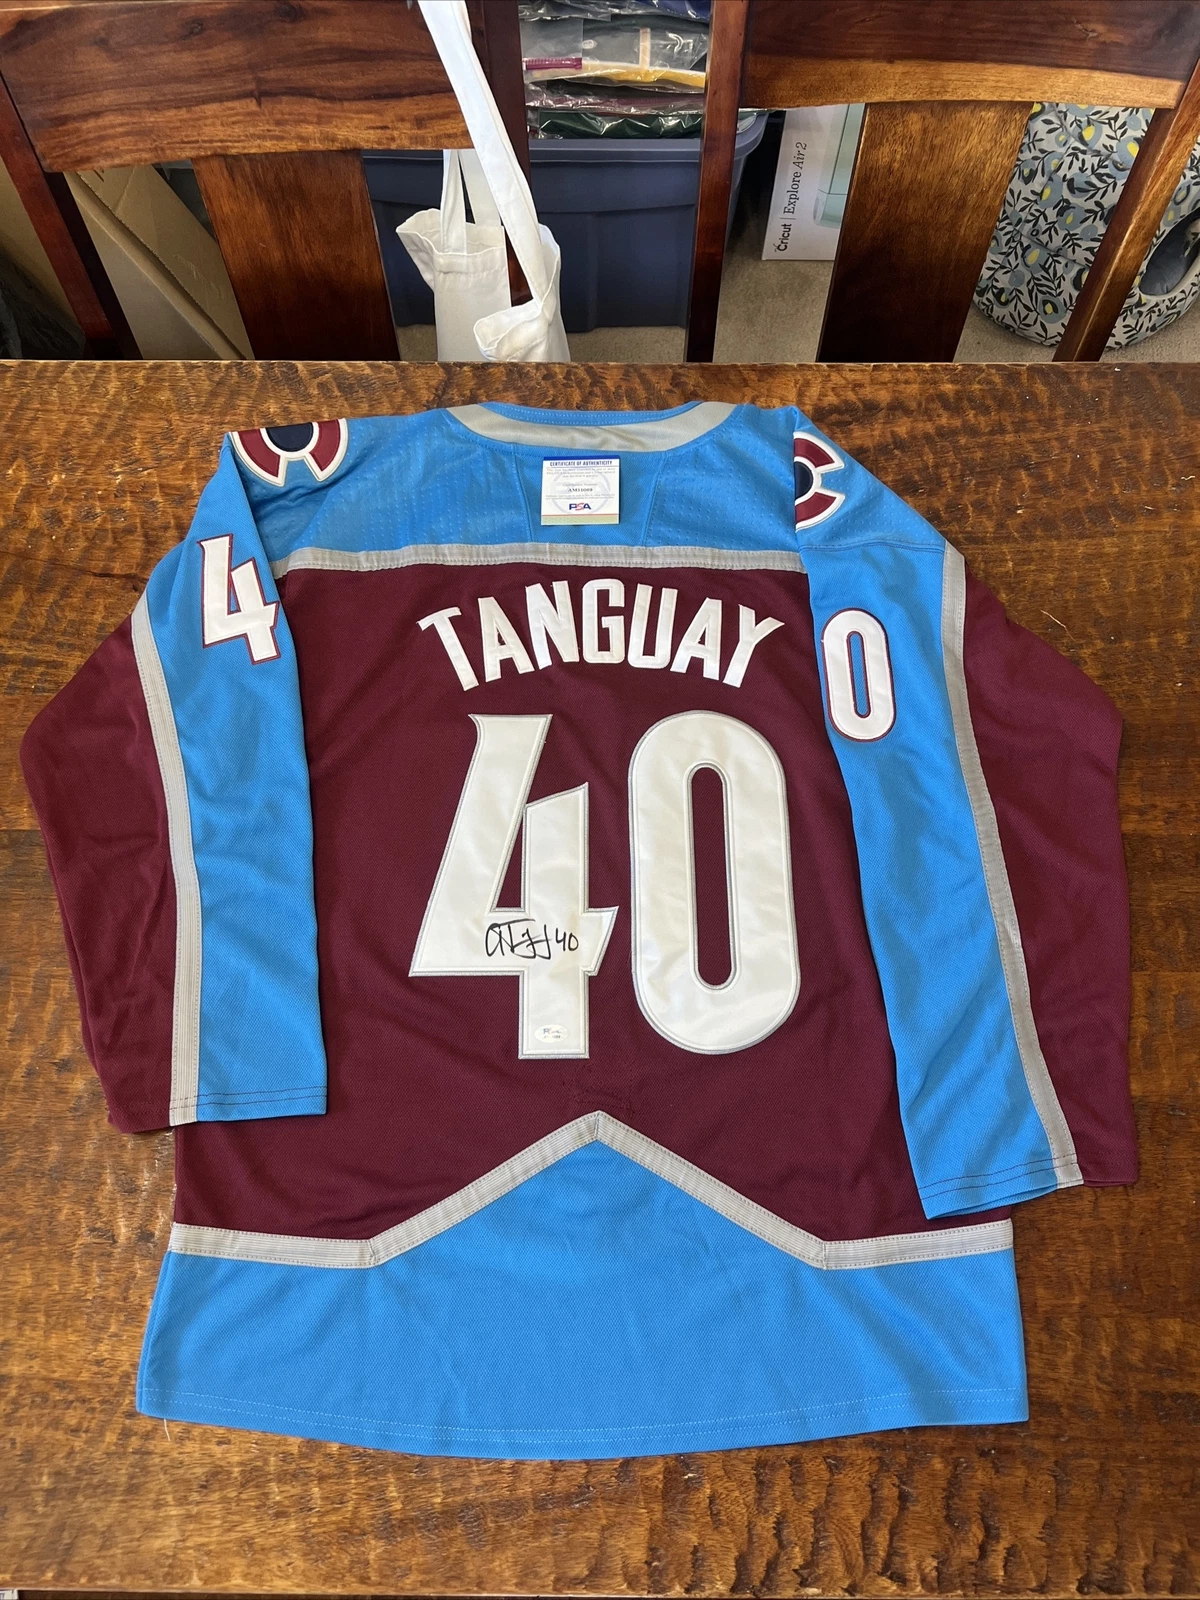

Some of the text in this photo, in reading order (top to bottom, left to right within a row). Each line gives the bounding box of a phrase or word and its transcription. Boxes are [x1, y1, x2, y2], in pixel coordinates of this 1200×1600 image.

[773, 141, 807, 252] Cricut Explore Air 2
[568, 502, 591, 511] PSA
[198, 533, 281, 665] 4
[416, 578, 785, 691] TANGUAY
[821, 607, 896, 742] 0
[408, 709, 801, 1060] 40
[555, 927, 579, 952] 40
